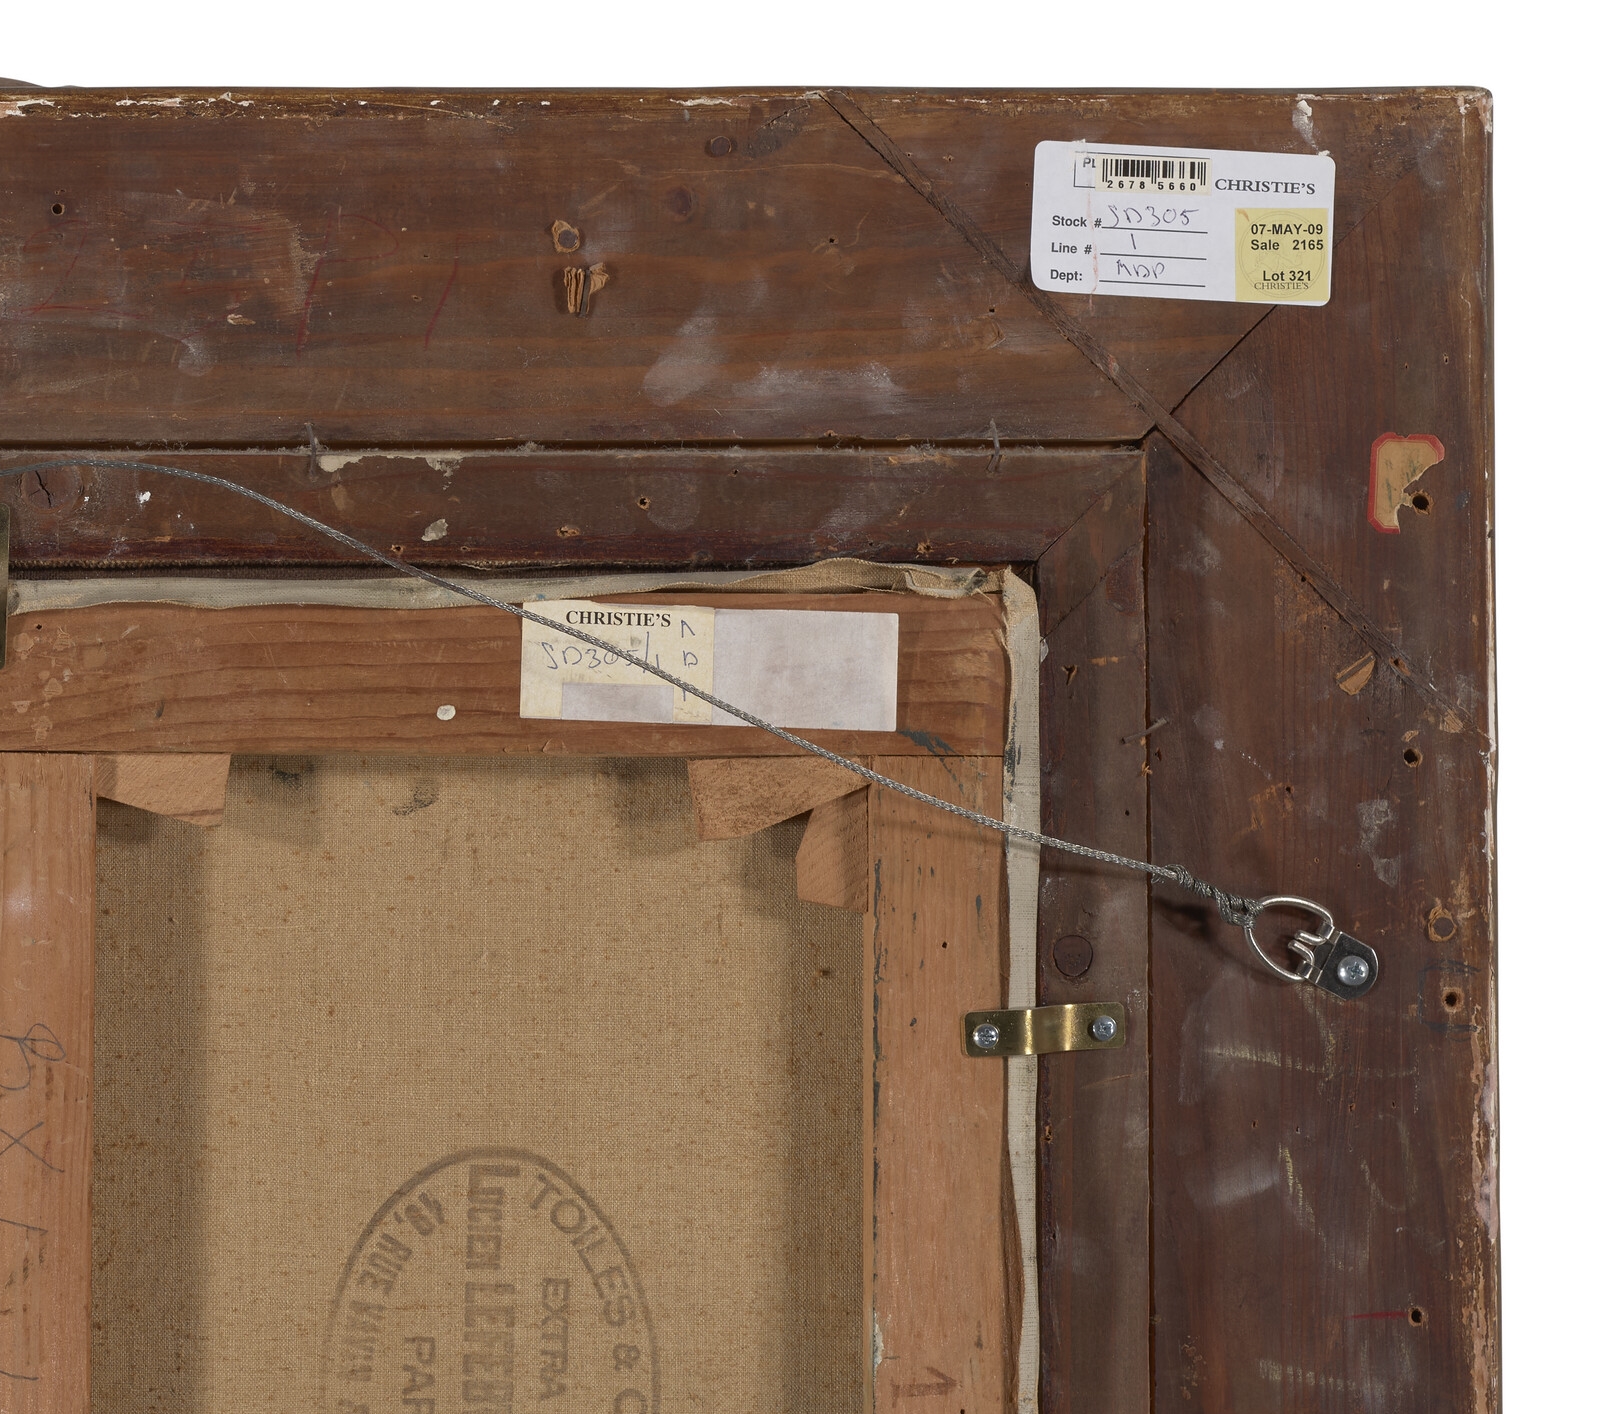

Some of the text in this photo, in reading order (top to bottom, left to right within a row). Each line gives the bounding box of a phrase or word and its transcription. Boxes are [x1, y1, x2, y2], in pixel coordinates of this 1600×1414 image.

[1214, 178, 1316, 195] CHRISTIE'S
[1051, 214, 1102, 229] Stock #
[1250, 223, 1323, 235] 07-MAY-09
[1051, 242, 1093, 255] Line #
[1250, 239, 1324, 251] Sale 2165
[1050, 269, 1083, 282] Dept:
[1262, 270, 1311, 282] Lot 321
[1253, 281, 1309, 291] CHRISTIE'S
[565, 610, 672, 628] CHRISTIE'S
[357, 1233, 414, 1297] RUE
[528, 1172, 635, 1328] TOILES
[611, 1343, 642, 1372] &
[539, 1277, 571, 1401] EXTRA
